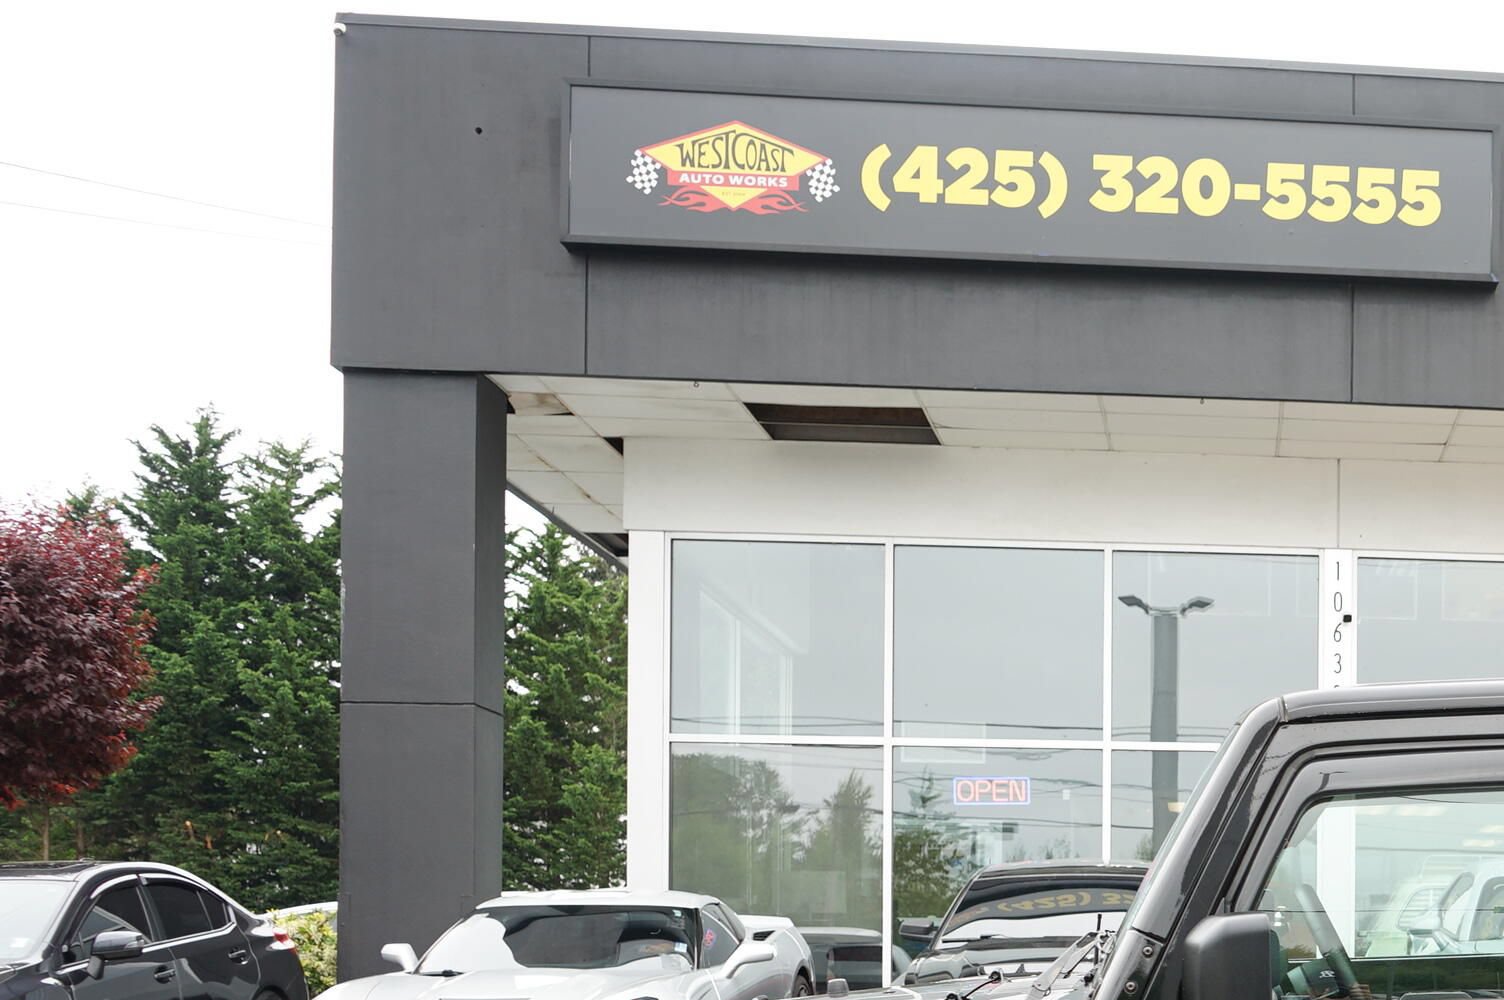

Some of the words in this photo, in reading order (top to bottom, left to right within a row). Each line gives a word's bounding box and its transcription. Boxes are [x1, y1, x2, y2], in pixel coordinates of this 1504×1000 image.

[677, 129, 795, 173] WESTCOAST
[679, 172, 724, 186] AUTO
[728, 175, 788, 188] WORKS
[861, 143, 1068, 218] (425)
[1089, 154, 1441, 226] 320-5555
[1333, 561, 1343, 688] 1063
[957, 780, 1026, 802] OPEN
